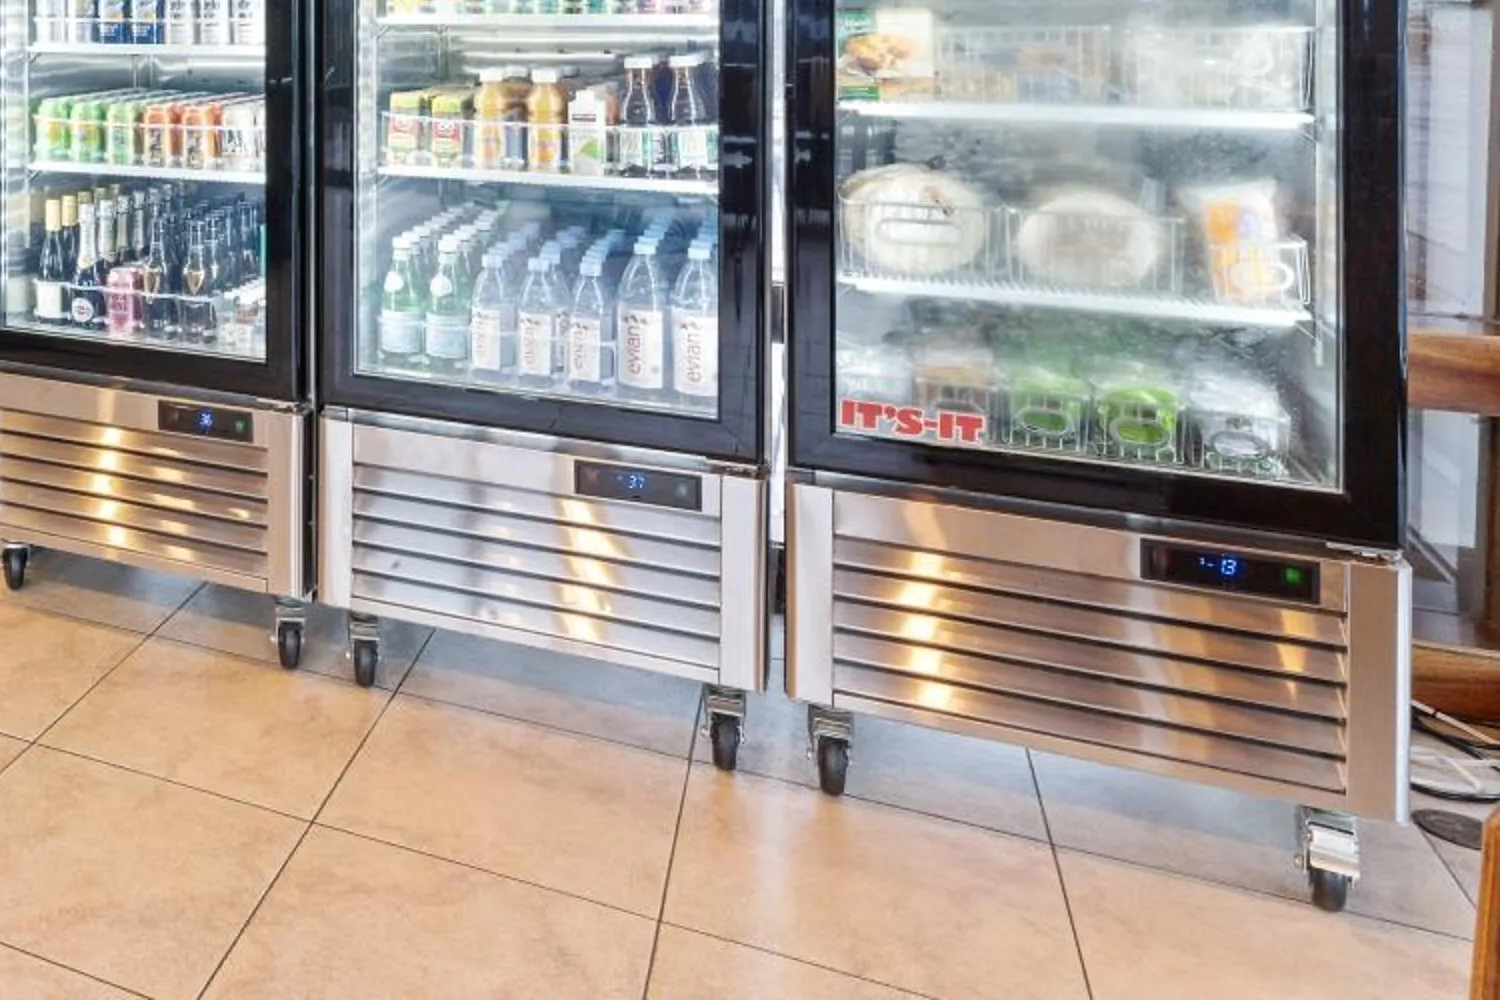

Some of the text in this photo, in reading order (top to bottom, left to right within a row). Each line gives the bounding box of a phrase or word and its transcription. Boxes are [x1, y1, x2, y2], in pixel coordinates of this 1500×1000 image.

[626, 323, 642, 375] evian
[686, 332, 702, 383] evian
[840, 399, 985, 443] IT'S-IT
[628, 475, 645, 489] 37
